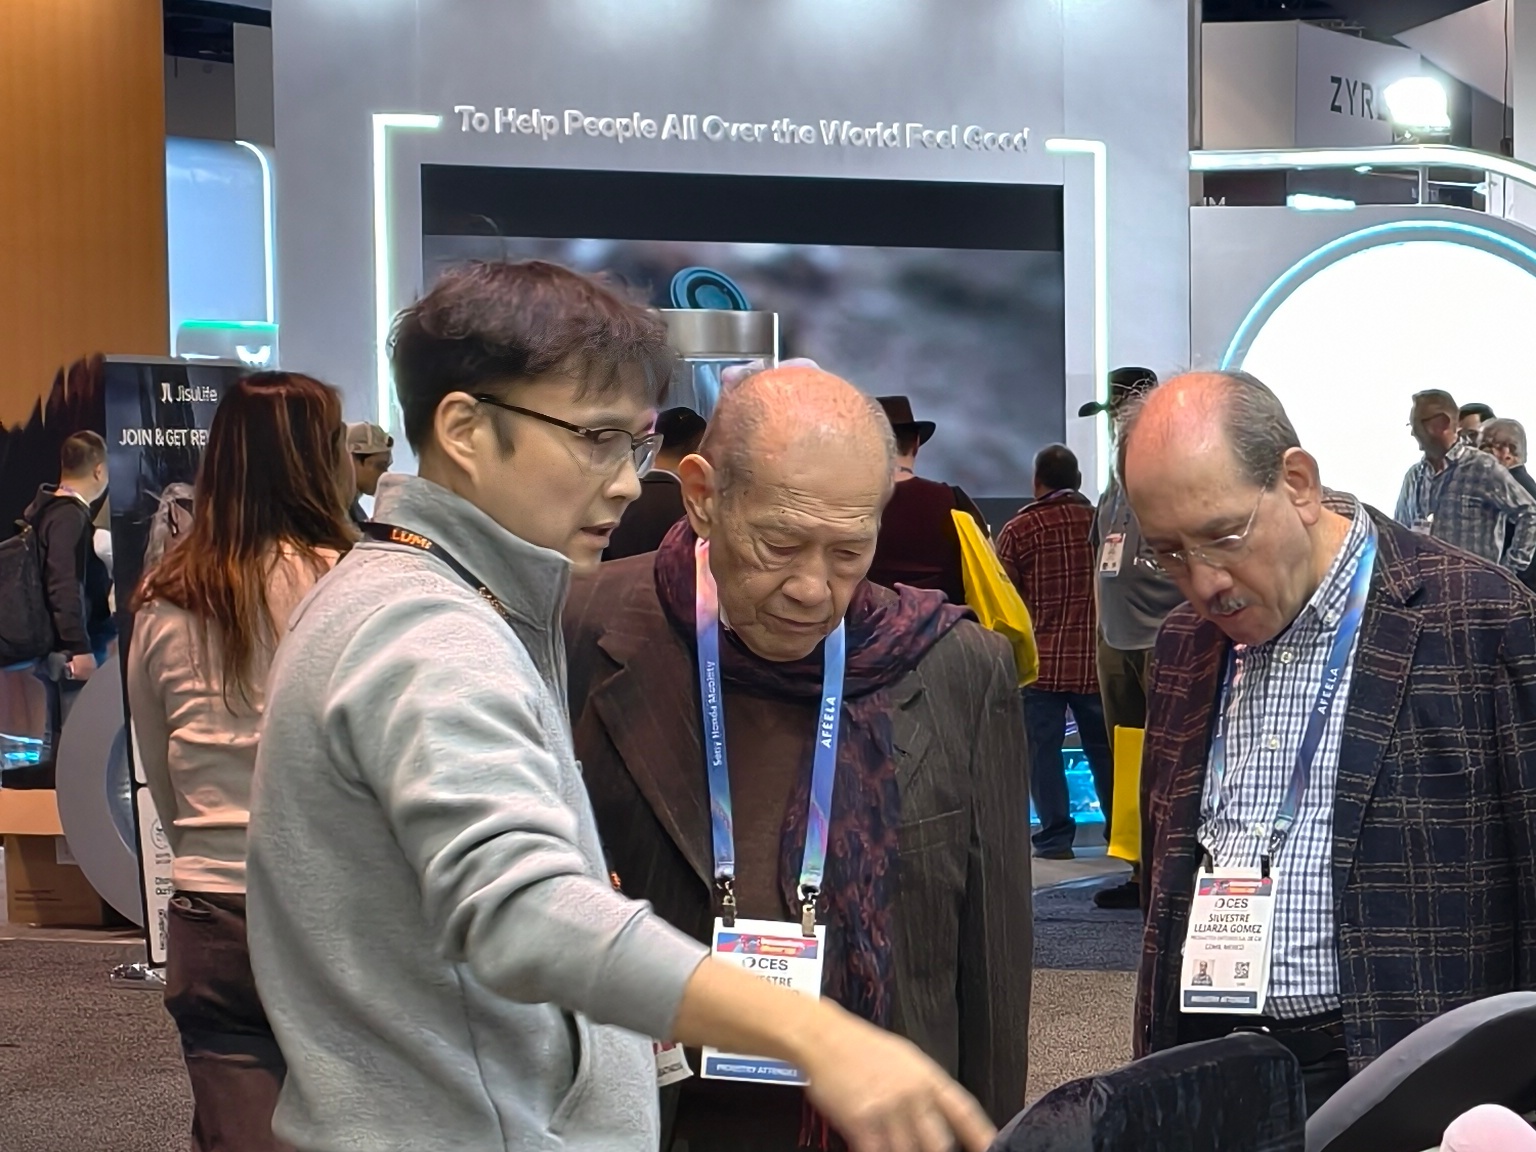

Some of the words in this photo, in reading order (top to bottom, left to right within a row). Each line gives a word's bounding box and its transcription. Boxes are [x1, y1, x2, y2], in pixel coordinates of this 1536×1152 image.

[454, 105, 490, 133] To
[494, 106, 560, 141] Help
[563, 109, 658, 144] People
[661, 113, 698, 141] All
[702, 115, 768, 143] Over
[771, 118, 817, 145] the
[819, 119, 900, 148] World
[905, 123, 959, 149] Feel
[963, 125, 1030, 152] Good
[119, 428, 152, 447] JOIN
[155, 429, 165, 447] &
[165, 429, 188, 447] GET
[1317, 667, 1340, 716] AFEELA
[820, 696, 837, 749] AFEELA
[1226, 898, 1249, 909] CES
[1208, 913, 1251, 923] SILVESTRE
[1230, 924, 1263, 934] GOMEZ
[758, 957, 789, 971] CES
